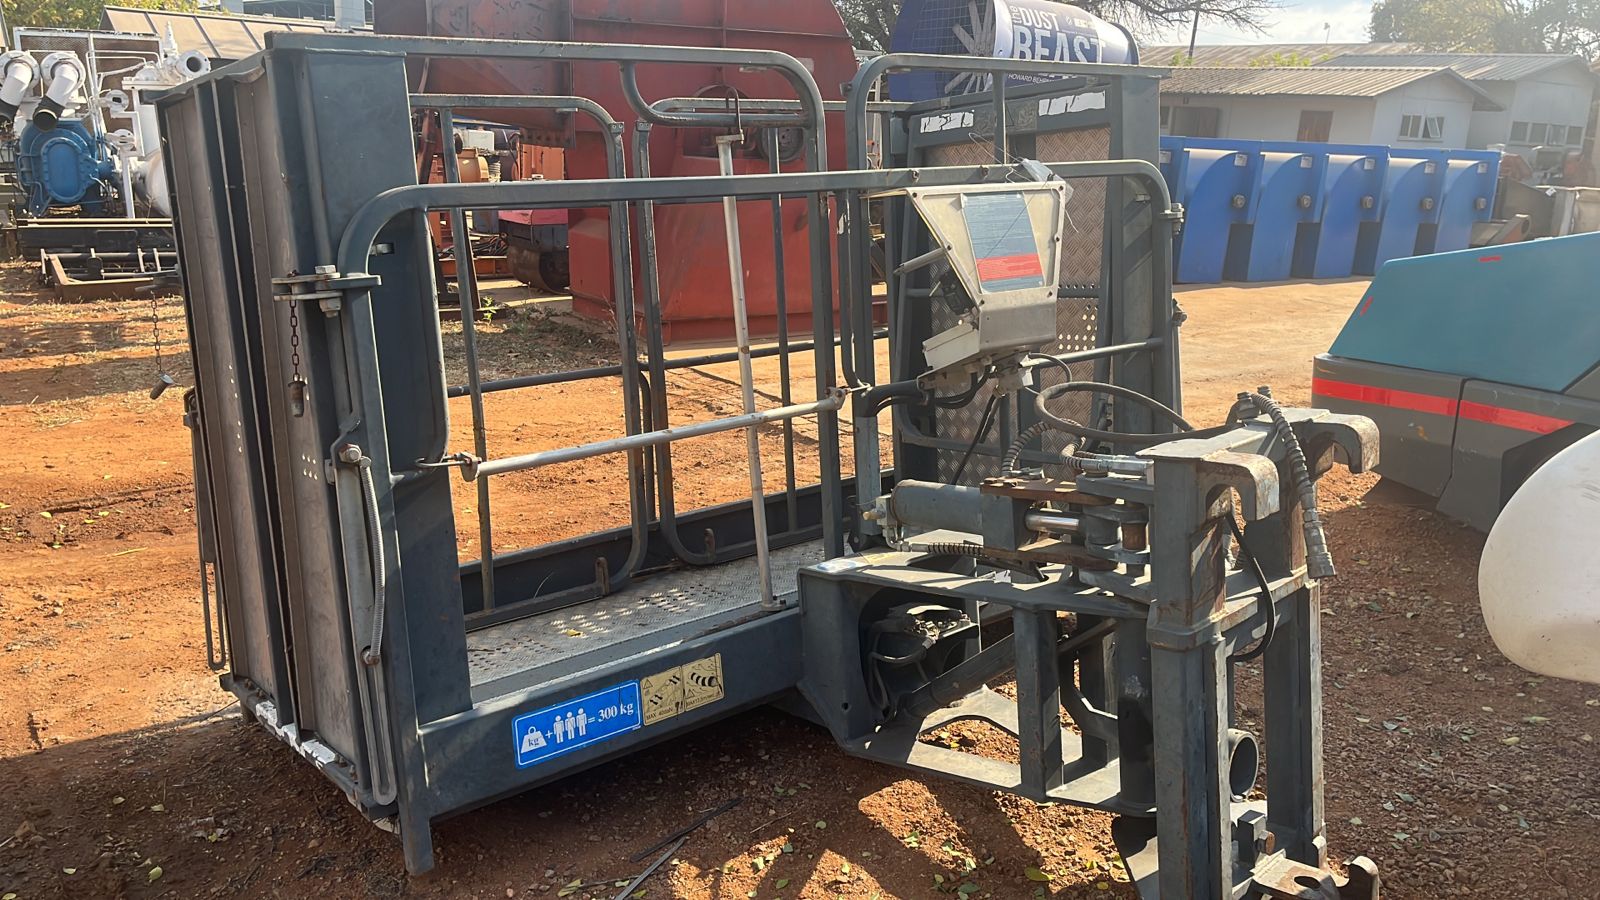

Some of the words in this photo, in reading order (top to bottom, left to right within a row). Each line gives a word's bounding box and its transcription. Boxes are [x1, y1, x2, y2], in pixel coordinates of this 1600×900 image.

[1020, 7, 1060, 31] DUST
[1013, 24, 1106, 64] BEAST
[1008, 73, 1032, 82] HOWARD
[528, 737, 540, 747] kg
[598, 705, 618, 722] 300
[619, 702, 634, 716] kg
